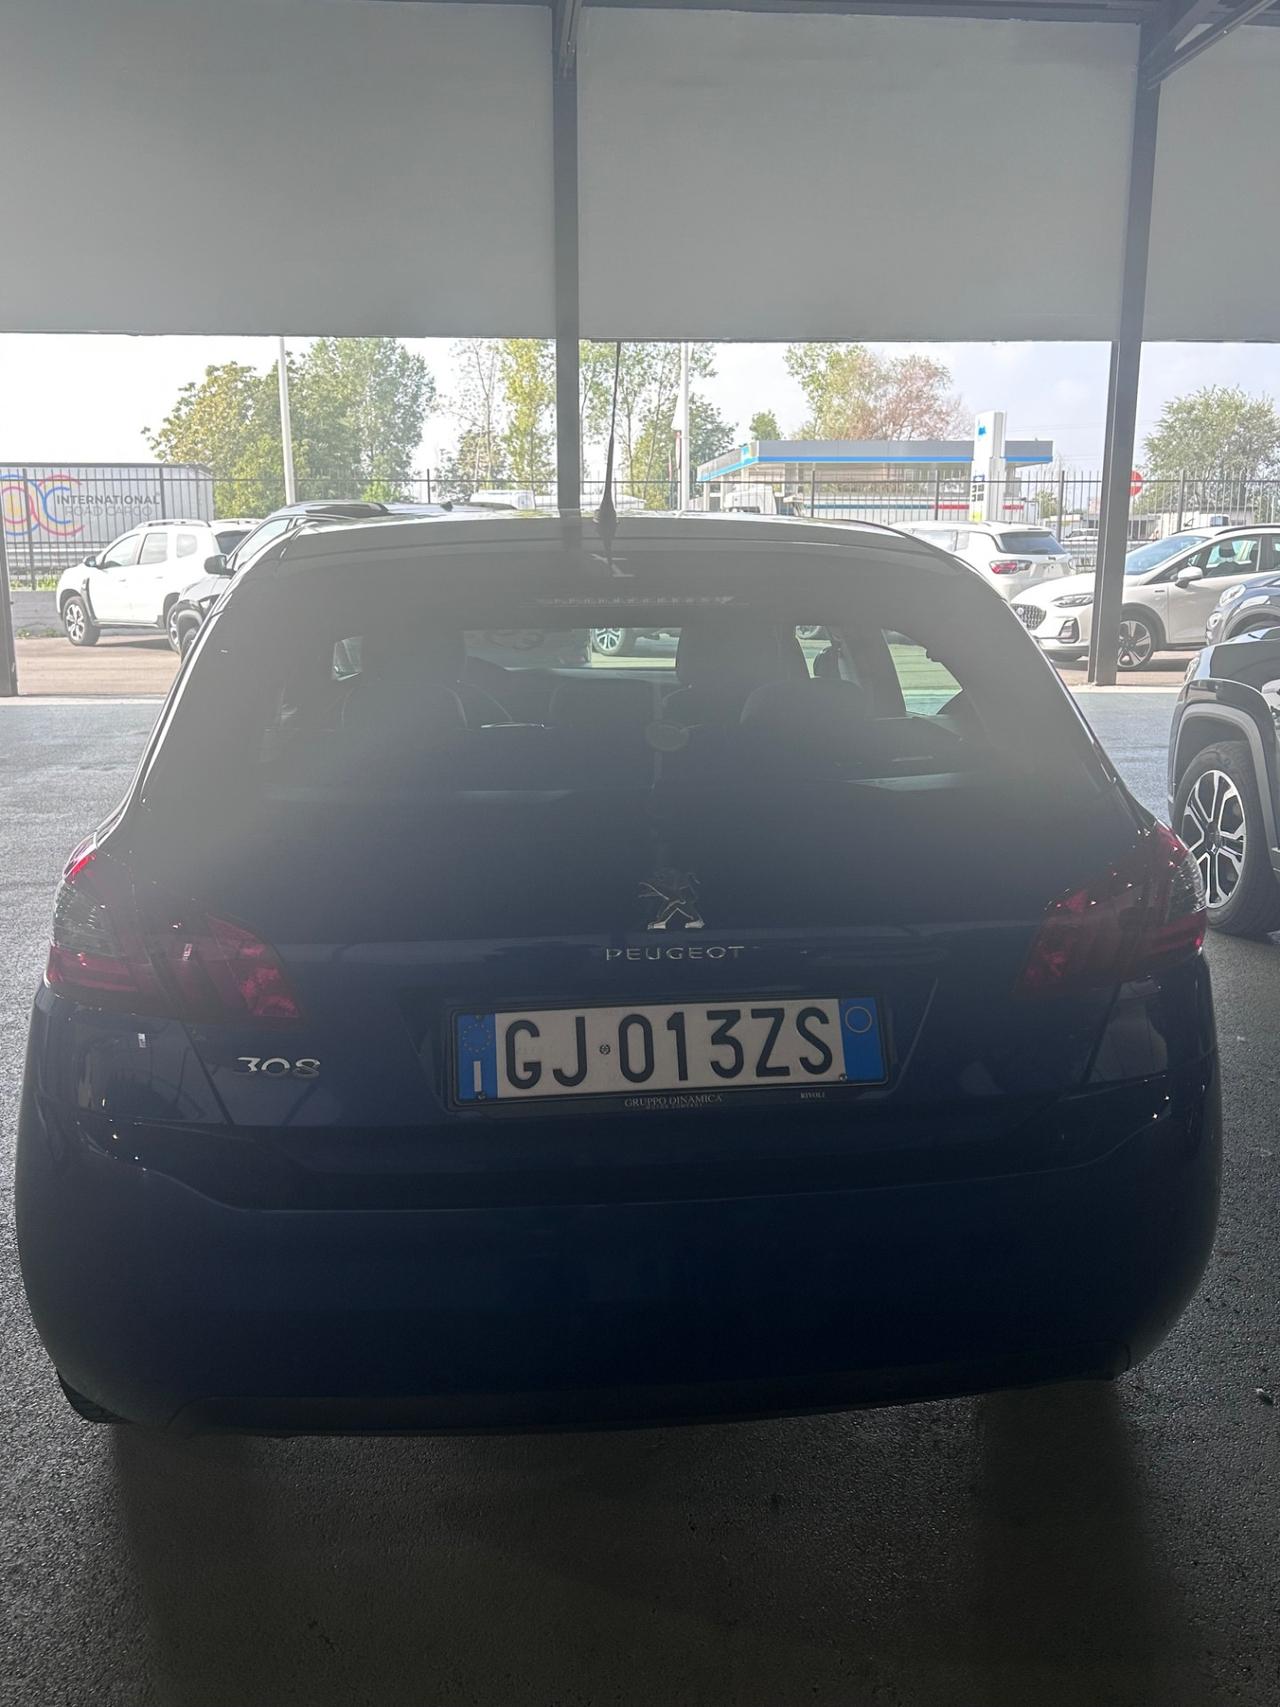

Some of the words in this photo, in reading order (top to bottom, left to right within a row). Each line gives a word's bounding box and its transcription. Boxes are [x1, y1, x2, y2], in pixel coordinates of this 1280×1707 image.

[57, 495, 160, 505] INTERNATIONAL
[65, 506, 103, 516] ROAD
[606, 946, 745, 961] PEUGEOT
[233, 1056, 321, 1078] 308
[624, 1096, 667, 1107] GRUPPO
[669, 1094, 723, 1105] DINAMICA
